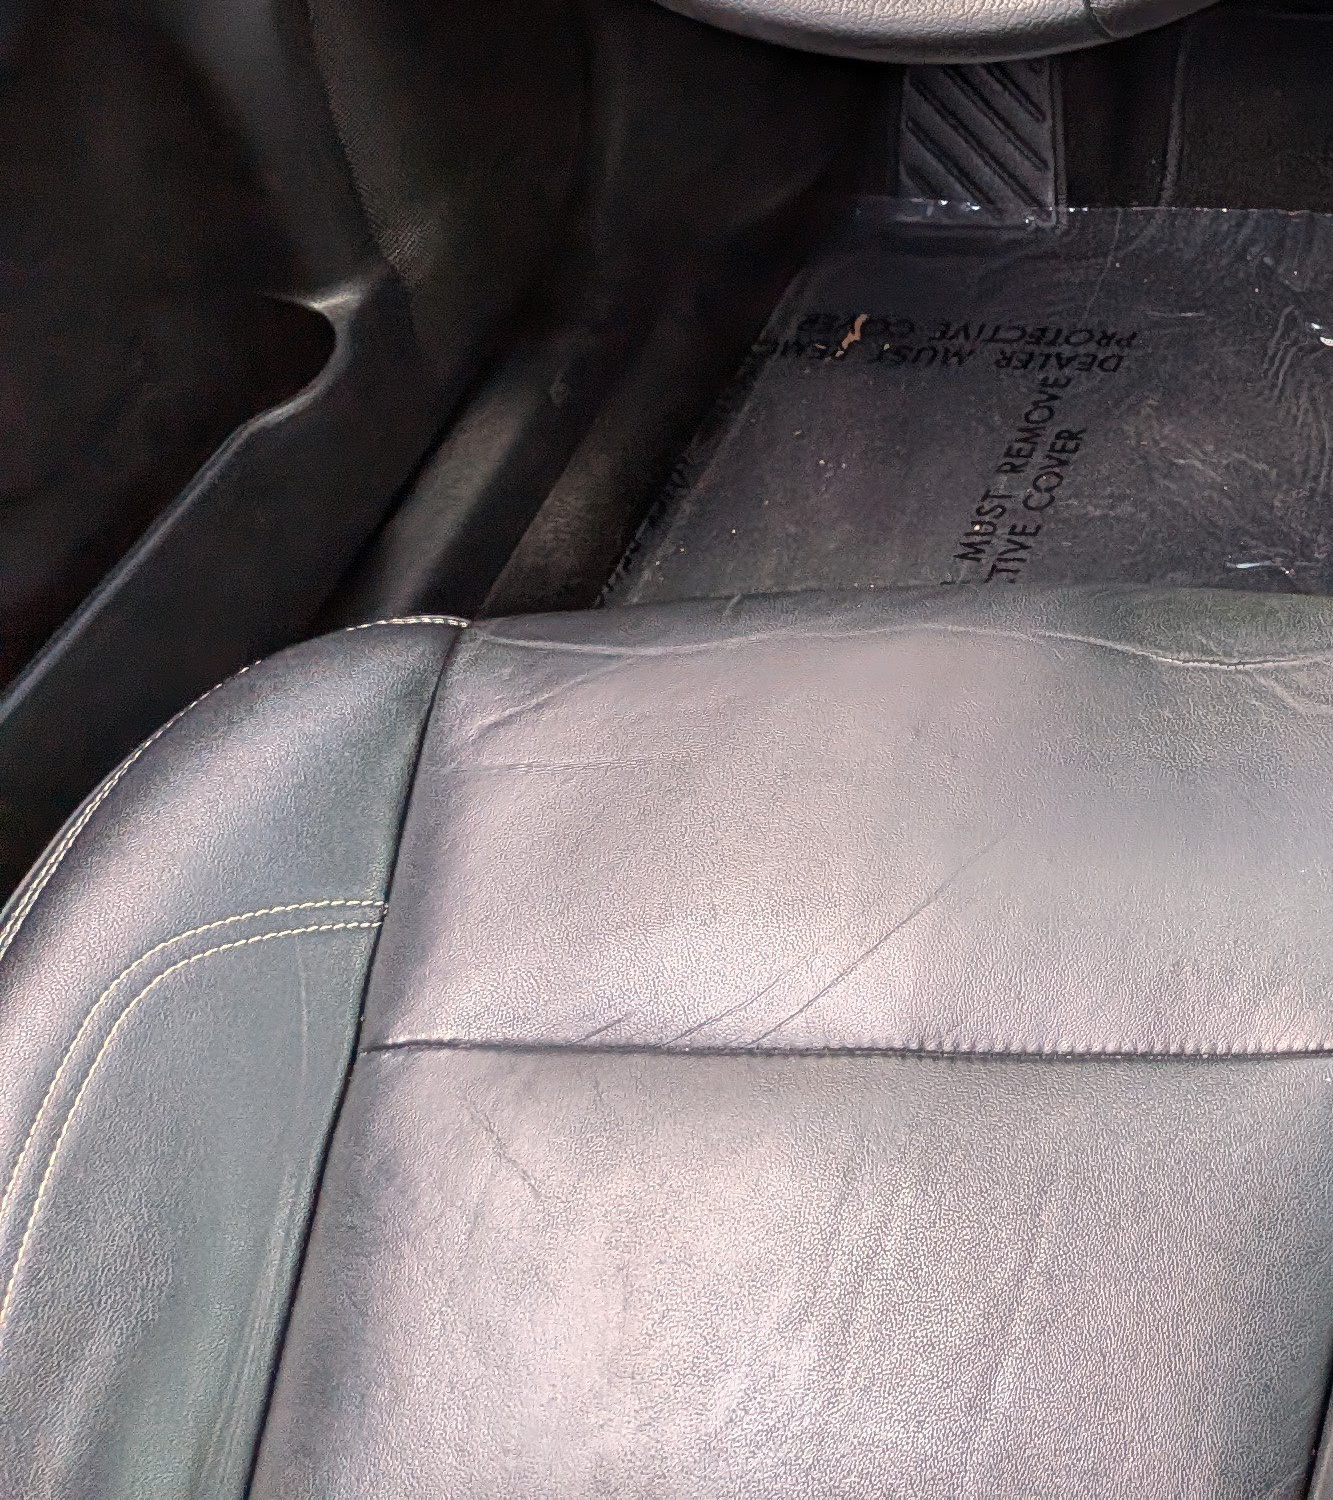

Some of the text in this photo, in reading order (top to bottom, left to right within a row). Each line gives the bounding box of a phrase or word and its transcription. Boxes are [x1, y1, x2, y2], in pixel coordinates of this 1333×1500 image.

[928, 321, 1139, 349] PROTECTIVE
[996, 350, 1125, 373] DEALER
[953, 374, 1073, 562] MUST REMOVE
[1022, 427, 1087, 512] COVER
